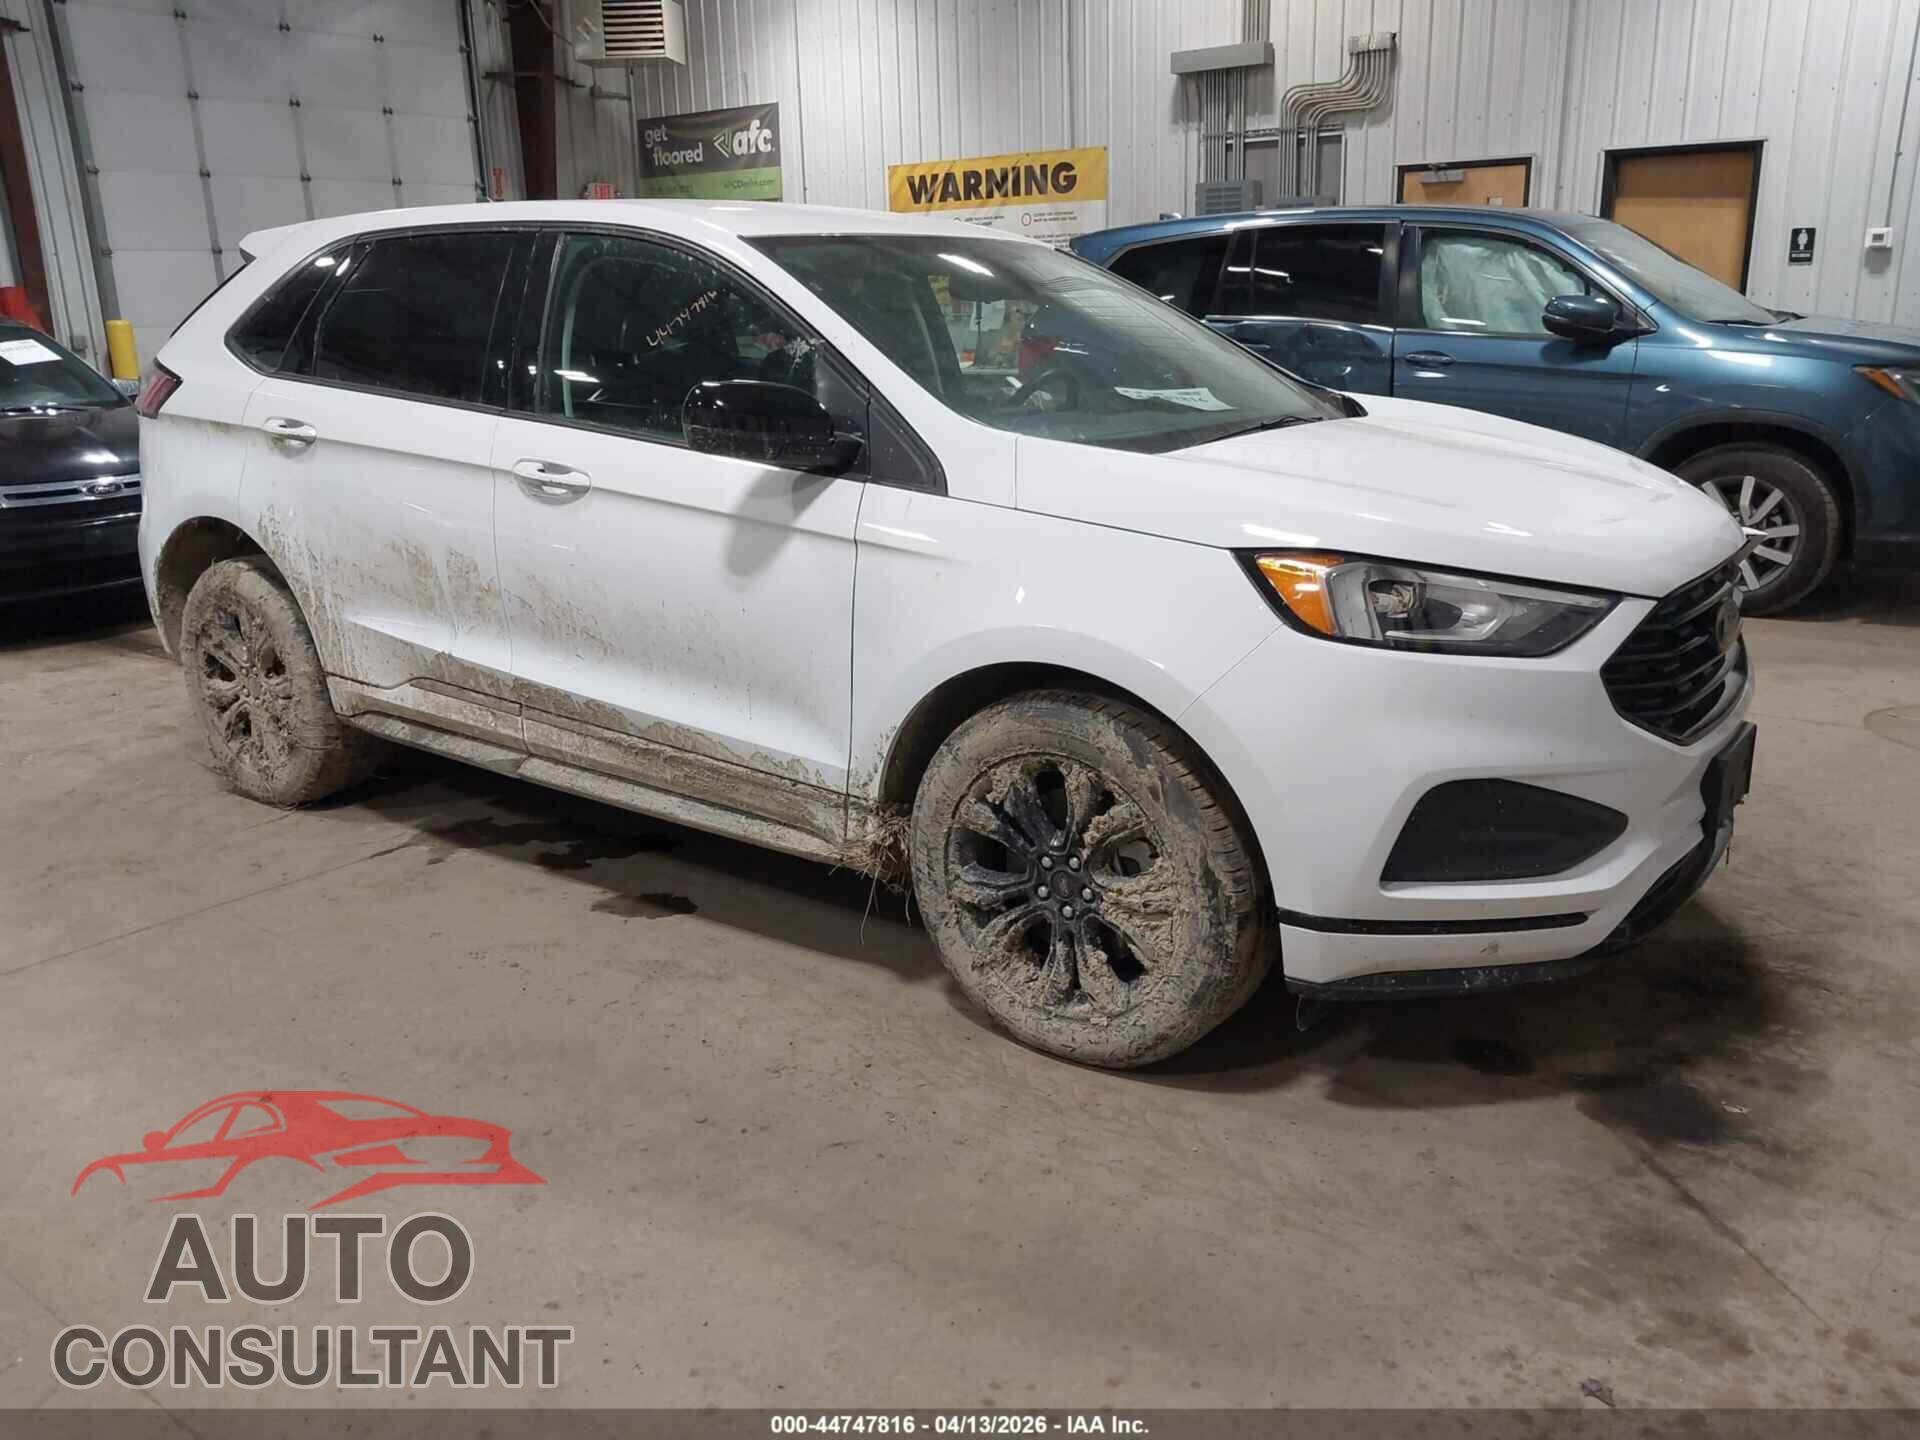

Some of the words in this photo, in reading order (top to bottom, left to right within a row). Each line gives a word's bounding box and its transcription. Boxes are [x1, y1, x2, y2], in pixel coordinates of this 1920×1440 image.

[645, 125, 668, 147] get
[732, 119, 773, 156] afc
[654, 143, 704, 166] floored
[906, 161, 1077, 205] WARNING
